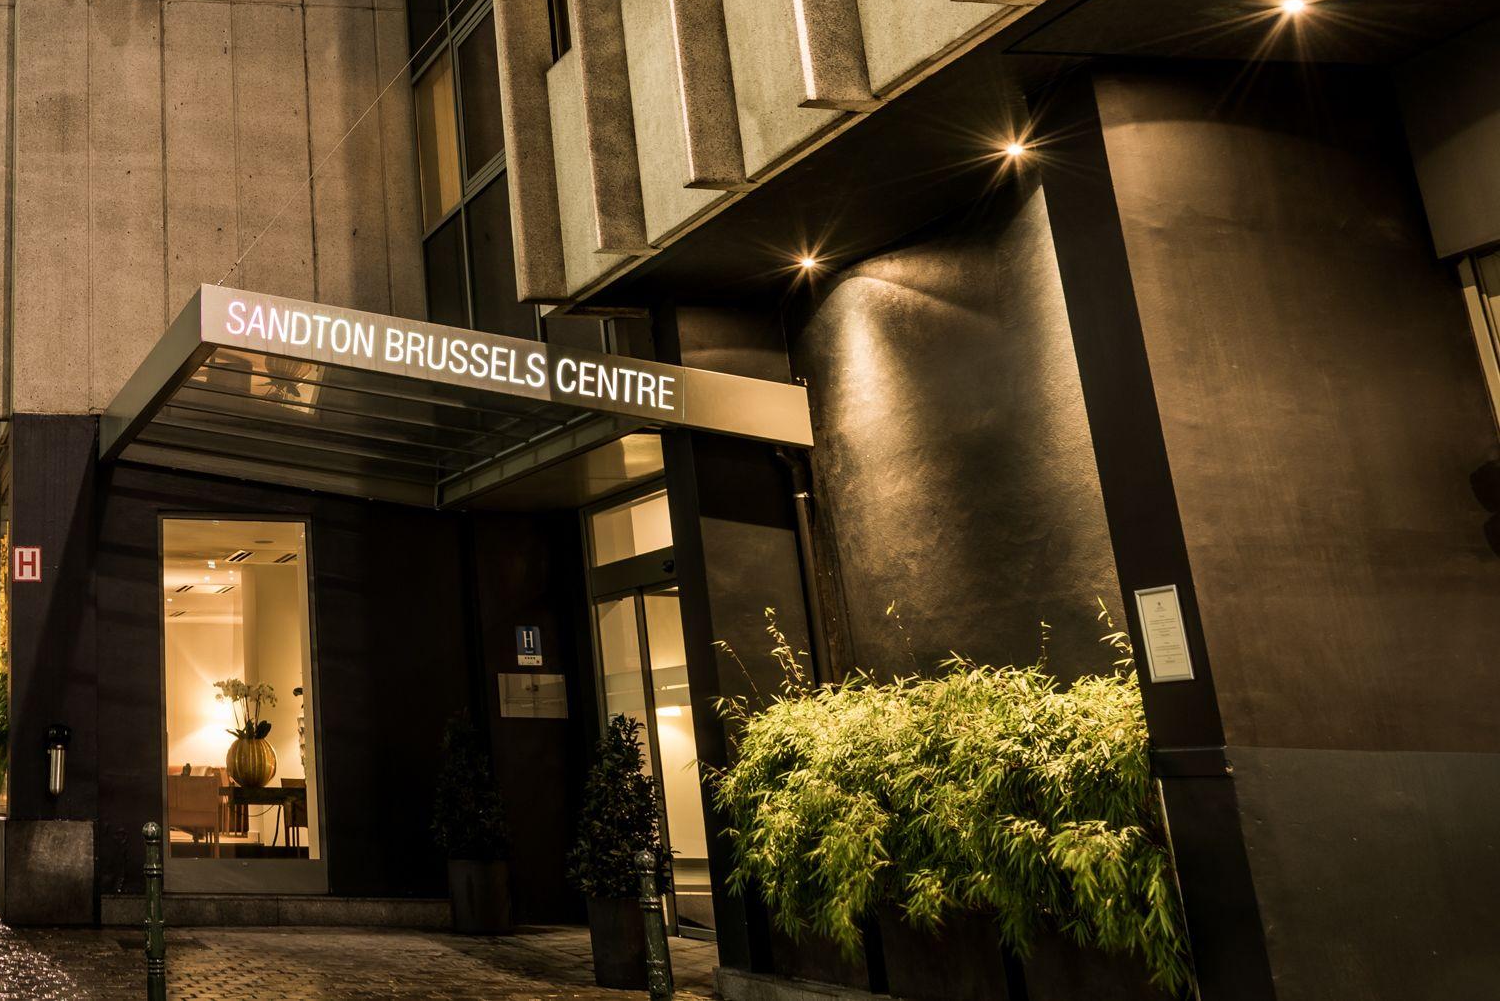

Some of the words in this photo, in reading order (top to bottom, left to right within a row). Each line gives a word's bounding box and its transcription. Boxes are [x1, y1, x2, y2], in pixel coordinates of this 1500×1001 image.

[225, 300, 375, 358] SANDTON
[385, 327, 547, 389] BRUSSELS
[556, 358, 676, 411] CENTRE
[18, 550, 37, 577] H
[522, 630, 534, 648] H
